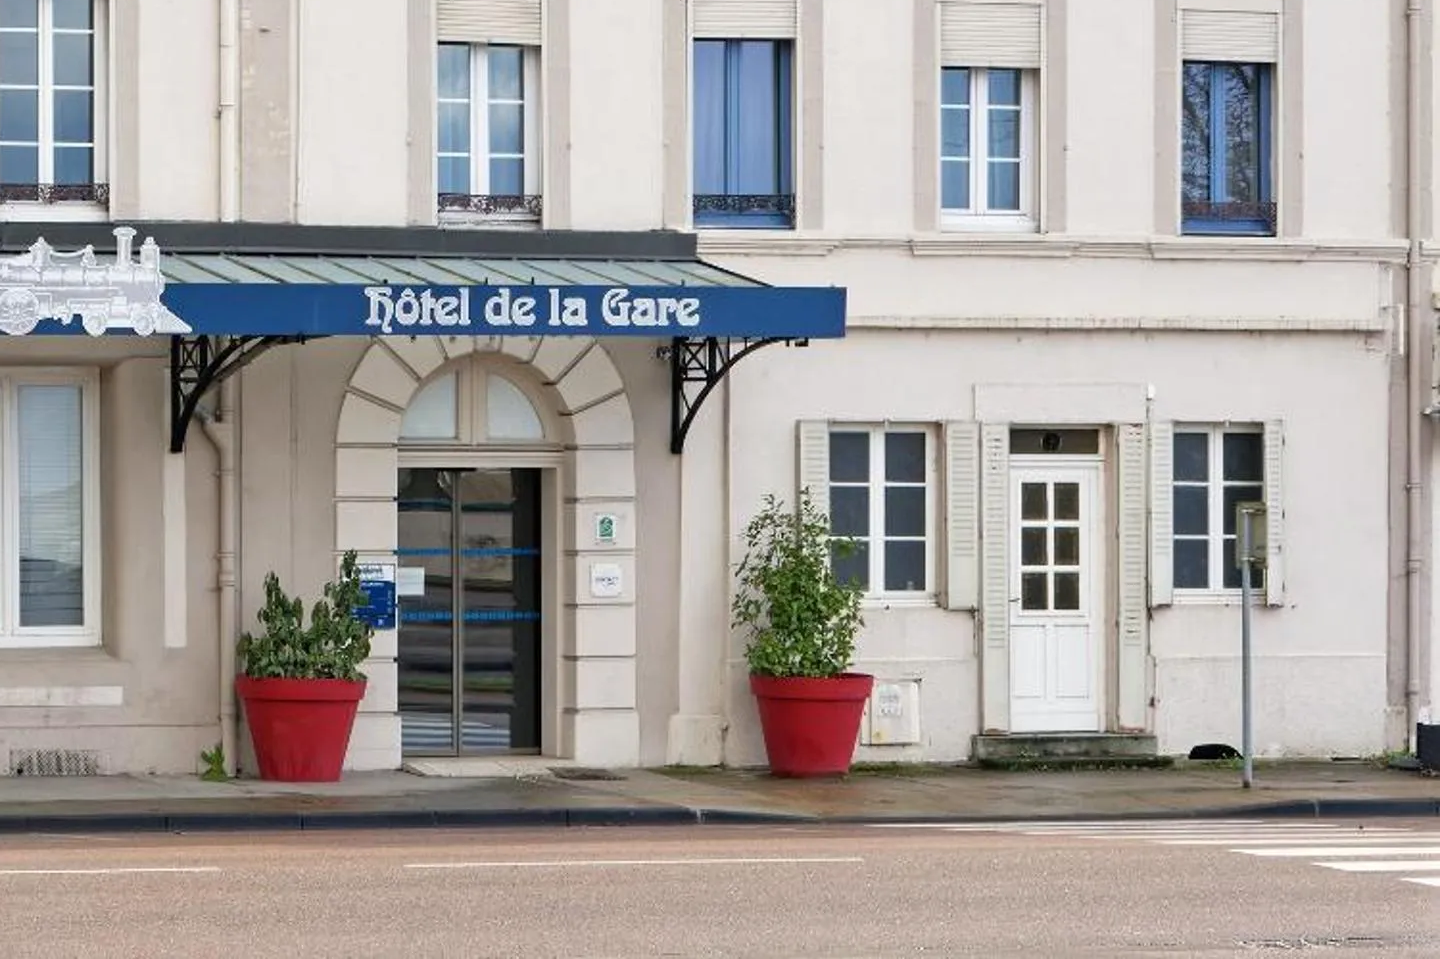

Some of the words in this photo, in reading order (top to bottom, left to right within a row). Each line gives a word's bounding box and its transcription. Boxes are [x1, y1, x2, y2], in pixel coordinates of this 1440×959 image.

[364, 286, 472, 334] Hôtel
[484, 287, 538, 327] de
[547, 288, 589, 328] la
[601, 287, 701, 328] Gare
